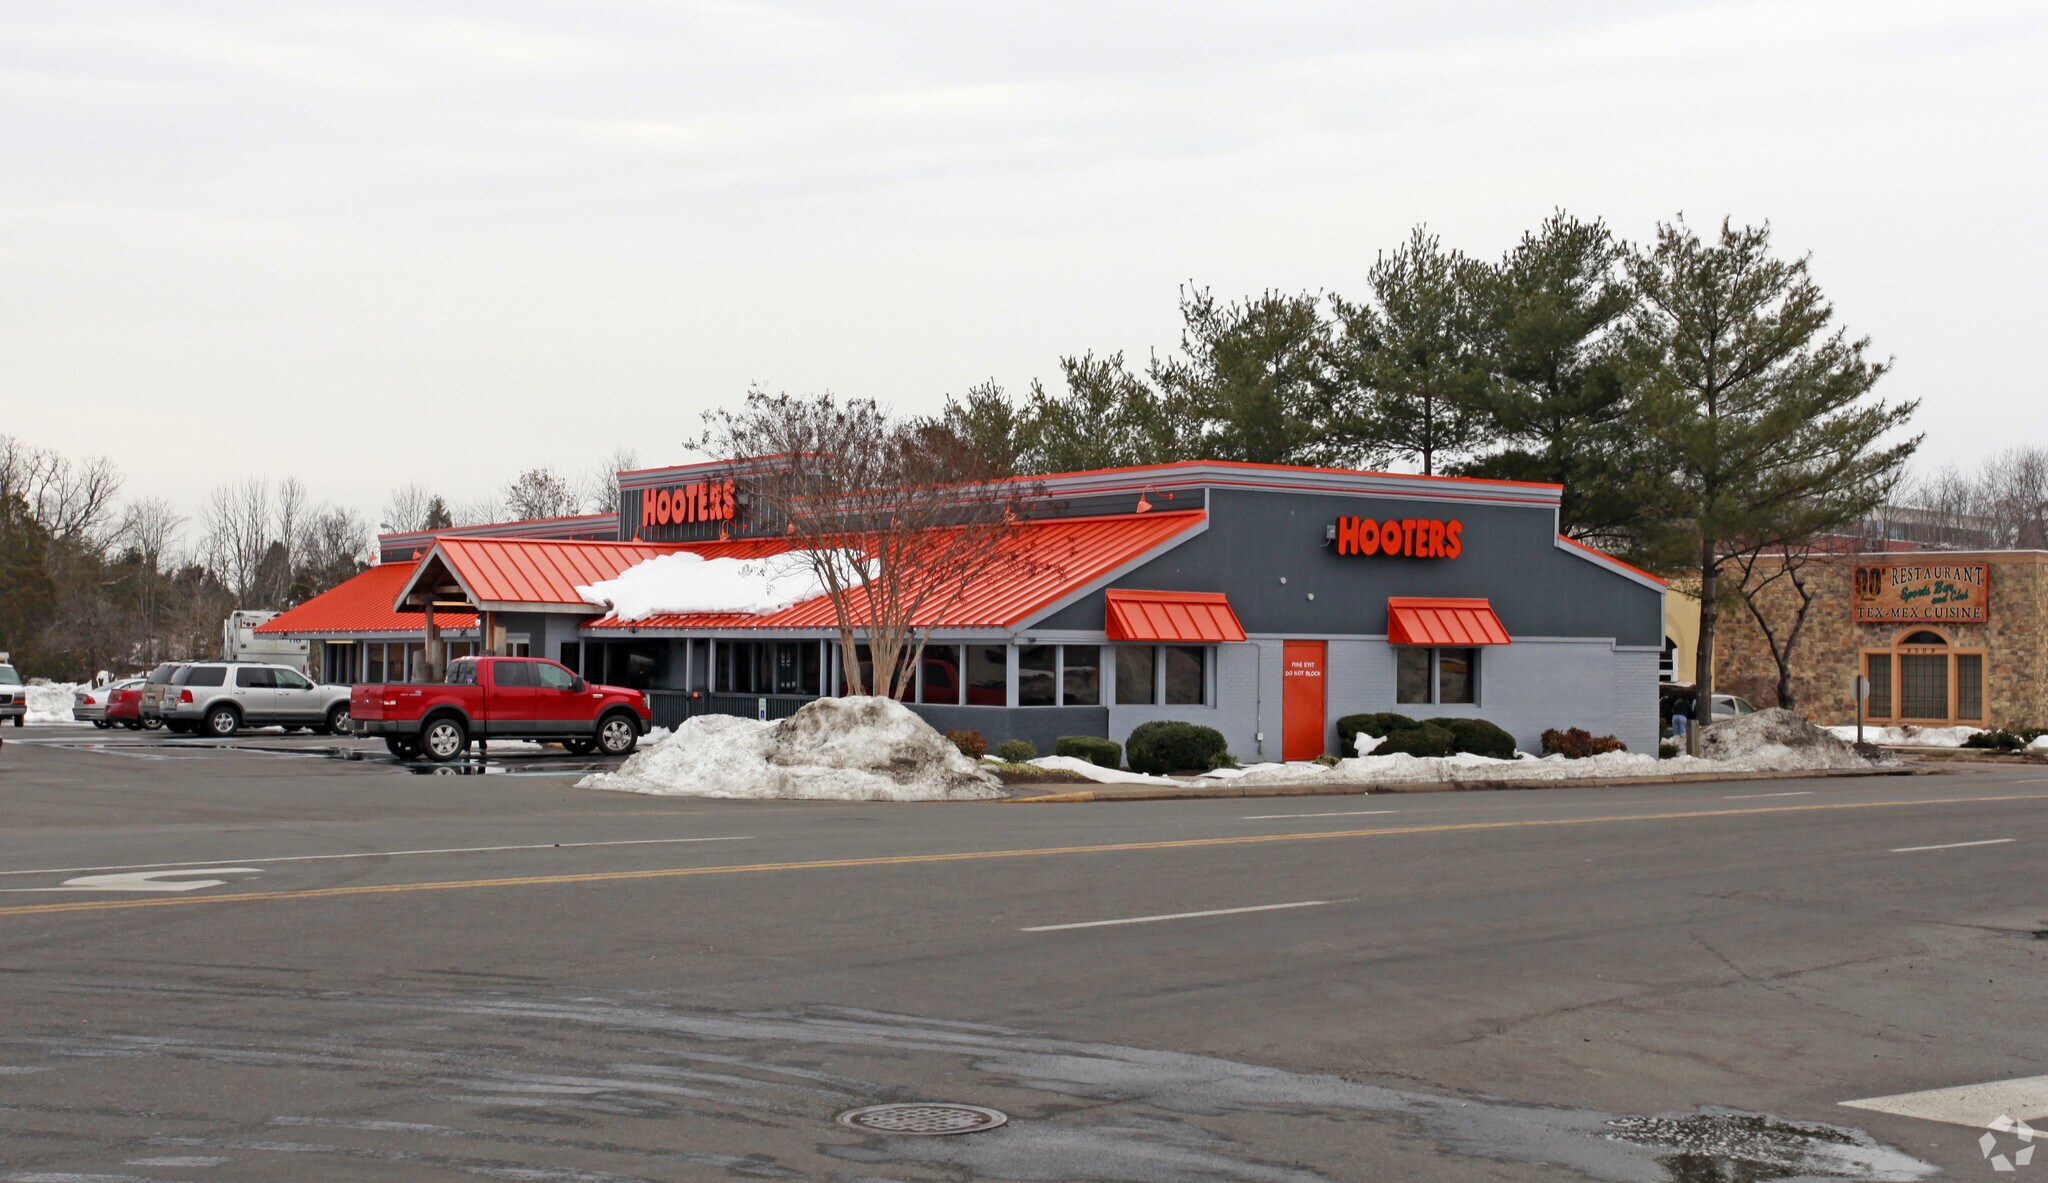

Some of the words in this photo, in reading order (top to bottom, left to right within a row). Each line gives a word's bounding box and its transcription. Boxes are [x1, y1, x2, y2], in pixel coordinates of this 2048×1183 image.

[642, 479, 736, 527] HOOTERS
[1338, 515, 1464, 559] HOOTERS
[1891, 566, 1982, 586] RESTAURANT
[1900, 585, 1931, 603] Sports
[1934, 580, 1954, 594] Bar
[1932, 593, 1948, 605] and
[1950, 588, 1969, 601] Club
[1858, 607, 1919, 618] TEX-MEX
[1924, 607, 1980, 618] CUISINE
